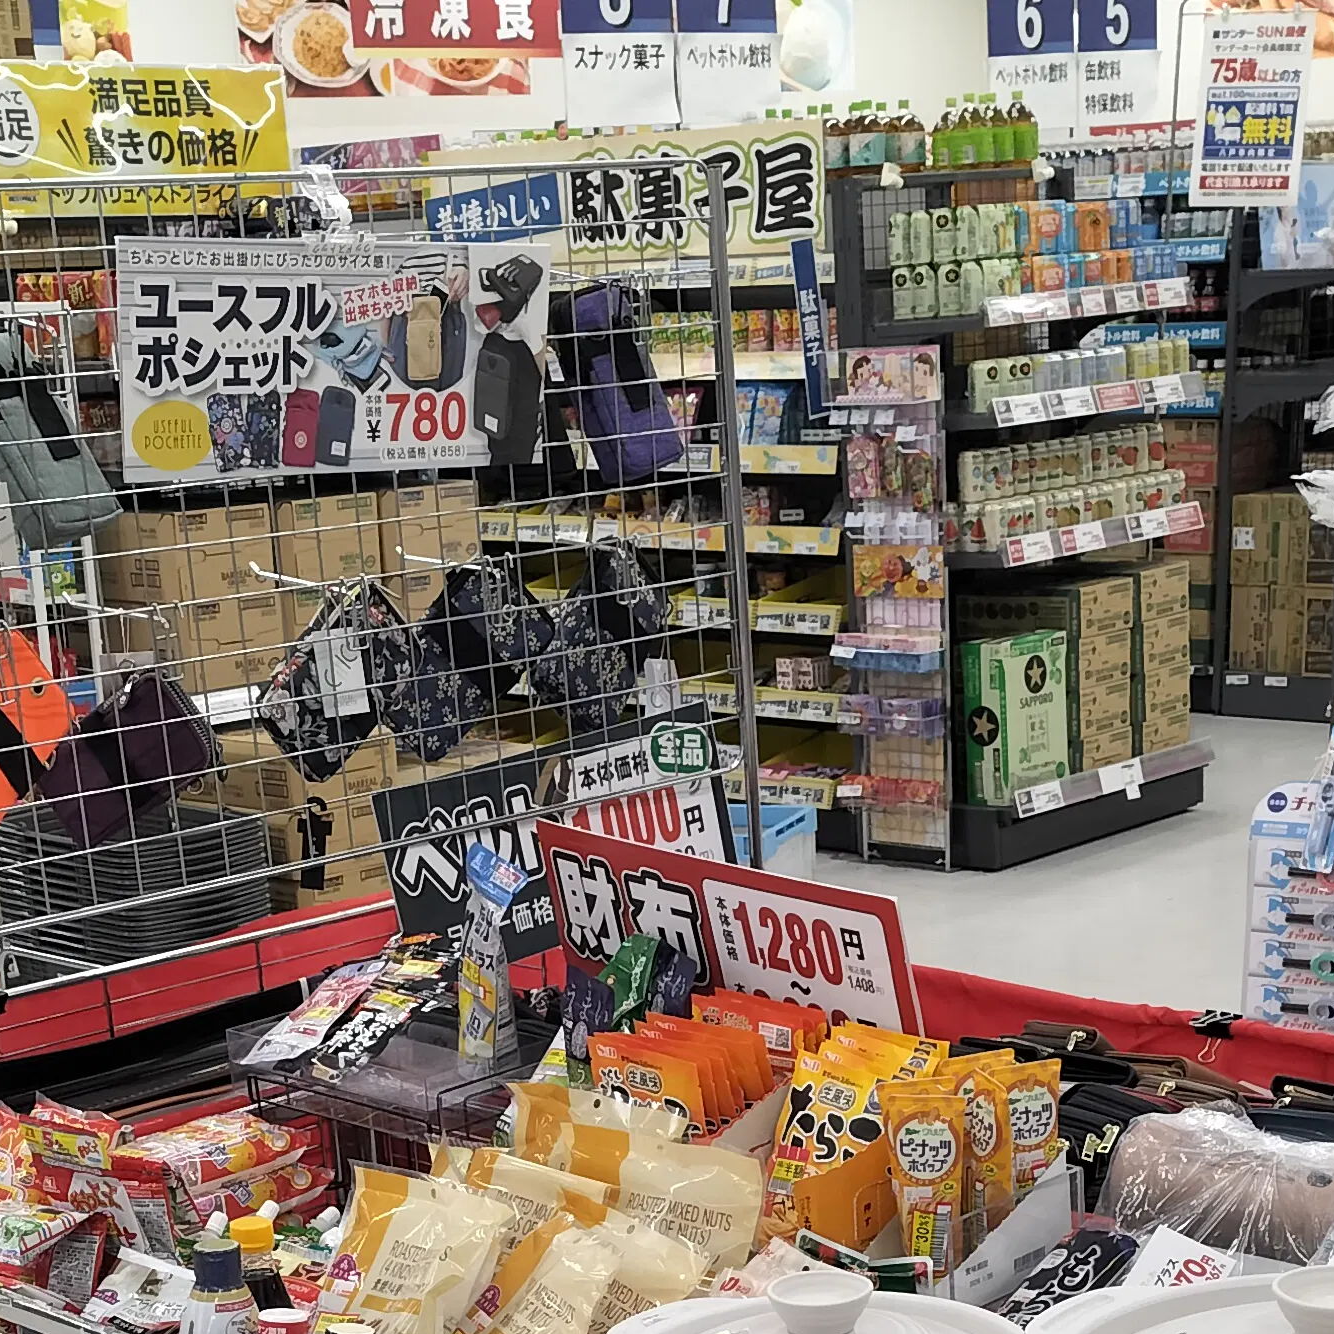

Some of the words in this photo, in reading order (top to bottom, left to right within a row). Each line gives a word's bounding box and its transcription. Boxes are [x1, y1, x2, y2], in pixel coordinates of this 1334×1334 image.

[1017, 0, 1043, 49] 6
[1105, 0, 1130, 45] 5
[574, 44, 665, 71] スナック菓子
[687, 44, 772, 69] ペットボトル飲料
[996, 62, 1068, 86] ペットボトル飲料
[1084, 60, 1120, 82] 缶飲料
[1211, 58, 1302, 83] 75歳以上の方
[88, 77, 214, 118] 満足品質
[1085, 92, 1134, 114] 特保飲料
[1243, 116, 1292, 144] 無料
[87, 129, 237, 166] 驚きの価格
[570, 139, 818, 250] 駄菓子屋
[344, 276, 418, 305] スマホも収納
[135, 282, 332, 332] ユースフル
[346, 298, 413, 323] 出来ちゃう!
[798, 290, 824, 366] 駄菓子
[135, 334, 308, 389] ポシェット
[153, 419, 194, 434] USEFUL
[144, 434, 204, 450] POCHETTE
[235, 657, 266, 670] BARREAL
[1020, 691, 1053, 708] SAPPORO
[657, 731, 704, 768] 全品
[578, 751, 648, 792] 本体価格
[553, 849, 708, 986] 財布
[714, 896, 737, 962] 本体価格
[734, 898, 865, 988] 1,280円
[626, 1067, 662, 1092] 生風味
[818, 1084, 857, 1111] 生風味
[1013, 1123, 1048, 1143] ホイップ
[899, 1136, 953, 1160] ピーナッツ
[907, 1156, 948, 1174] ホイップ
[627, 1192, 666, 1215] ROASTED
[667, 1200, 701, 1225] MIXED
[703, 1209, 734, 1231] NUTS
